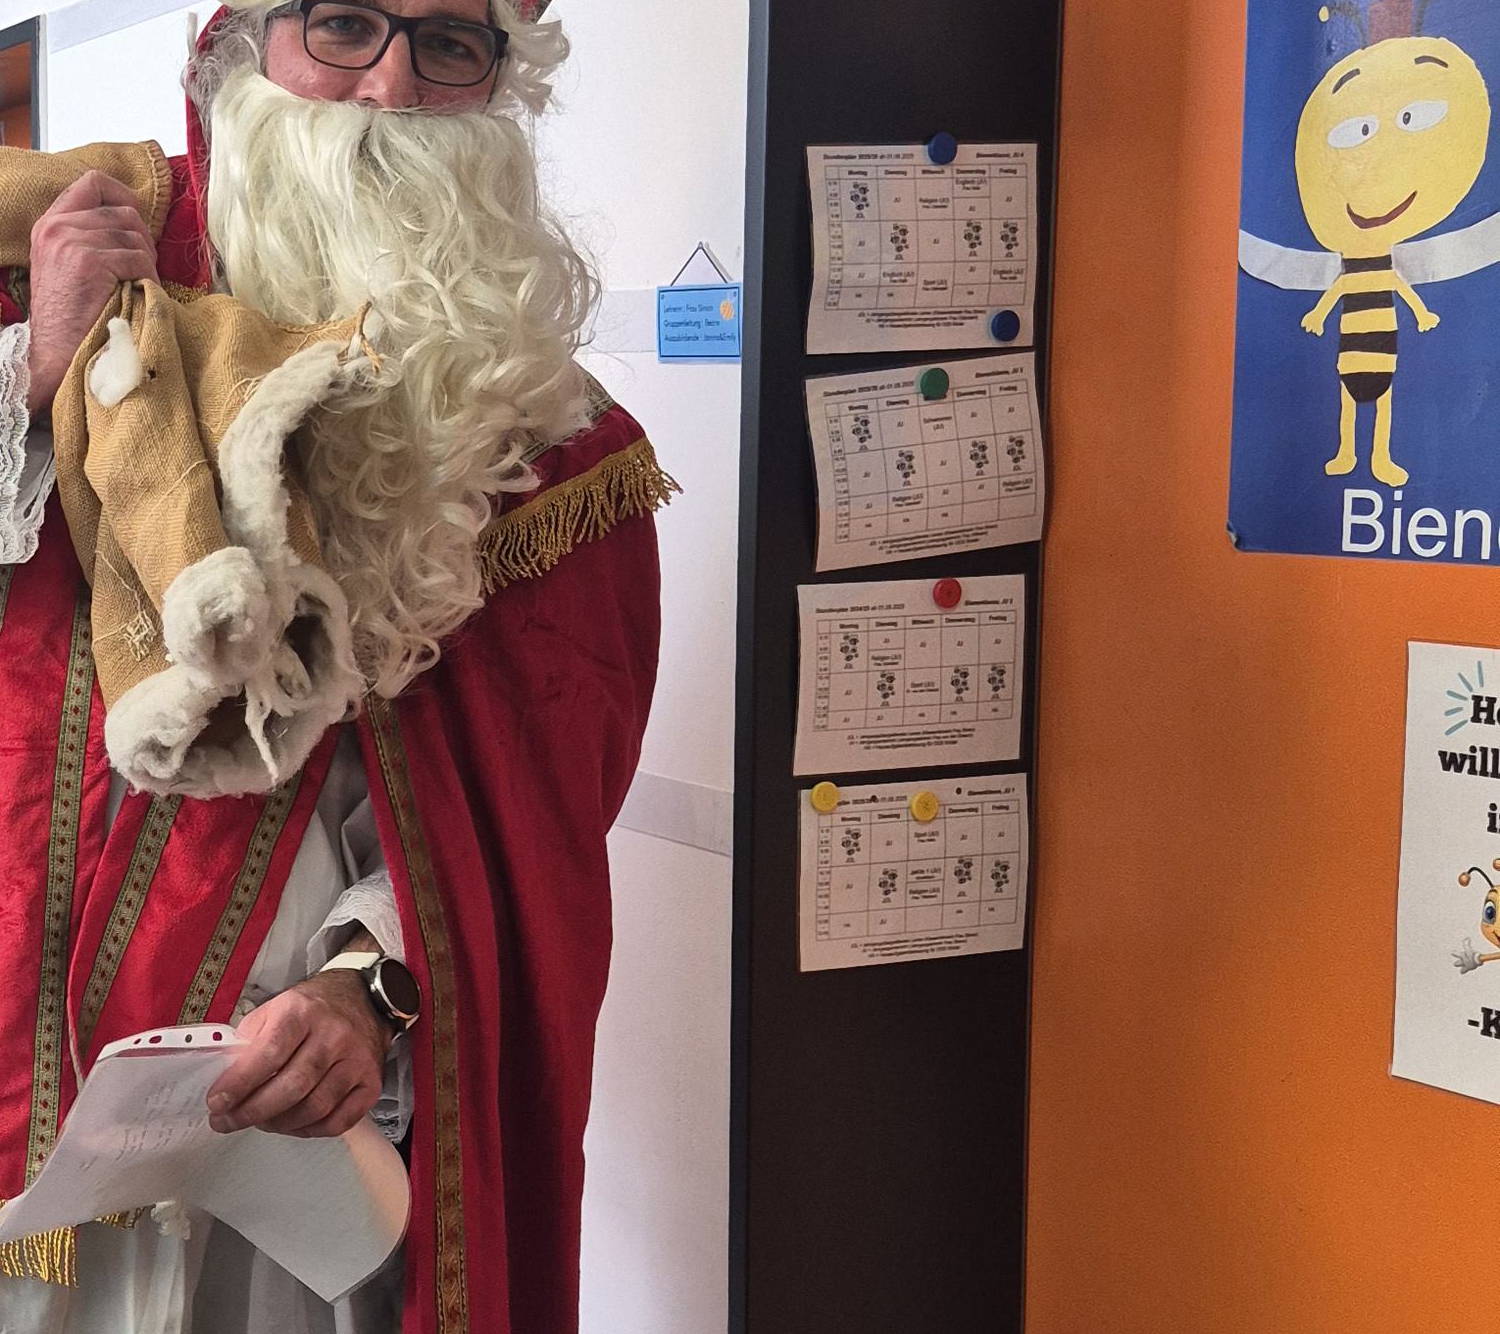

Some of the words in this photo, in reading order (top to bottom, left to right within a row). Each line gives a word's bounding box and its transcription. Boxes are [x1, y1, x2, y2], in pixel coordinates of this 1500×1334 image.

[1342, 488, 1500, 560] Bien
[1470, 694, 1500, 726] H
[1487, 802, 1500, 834] i
